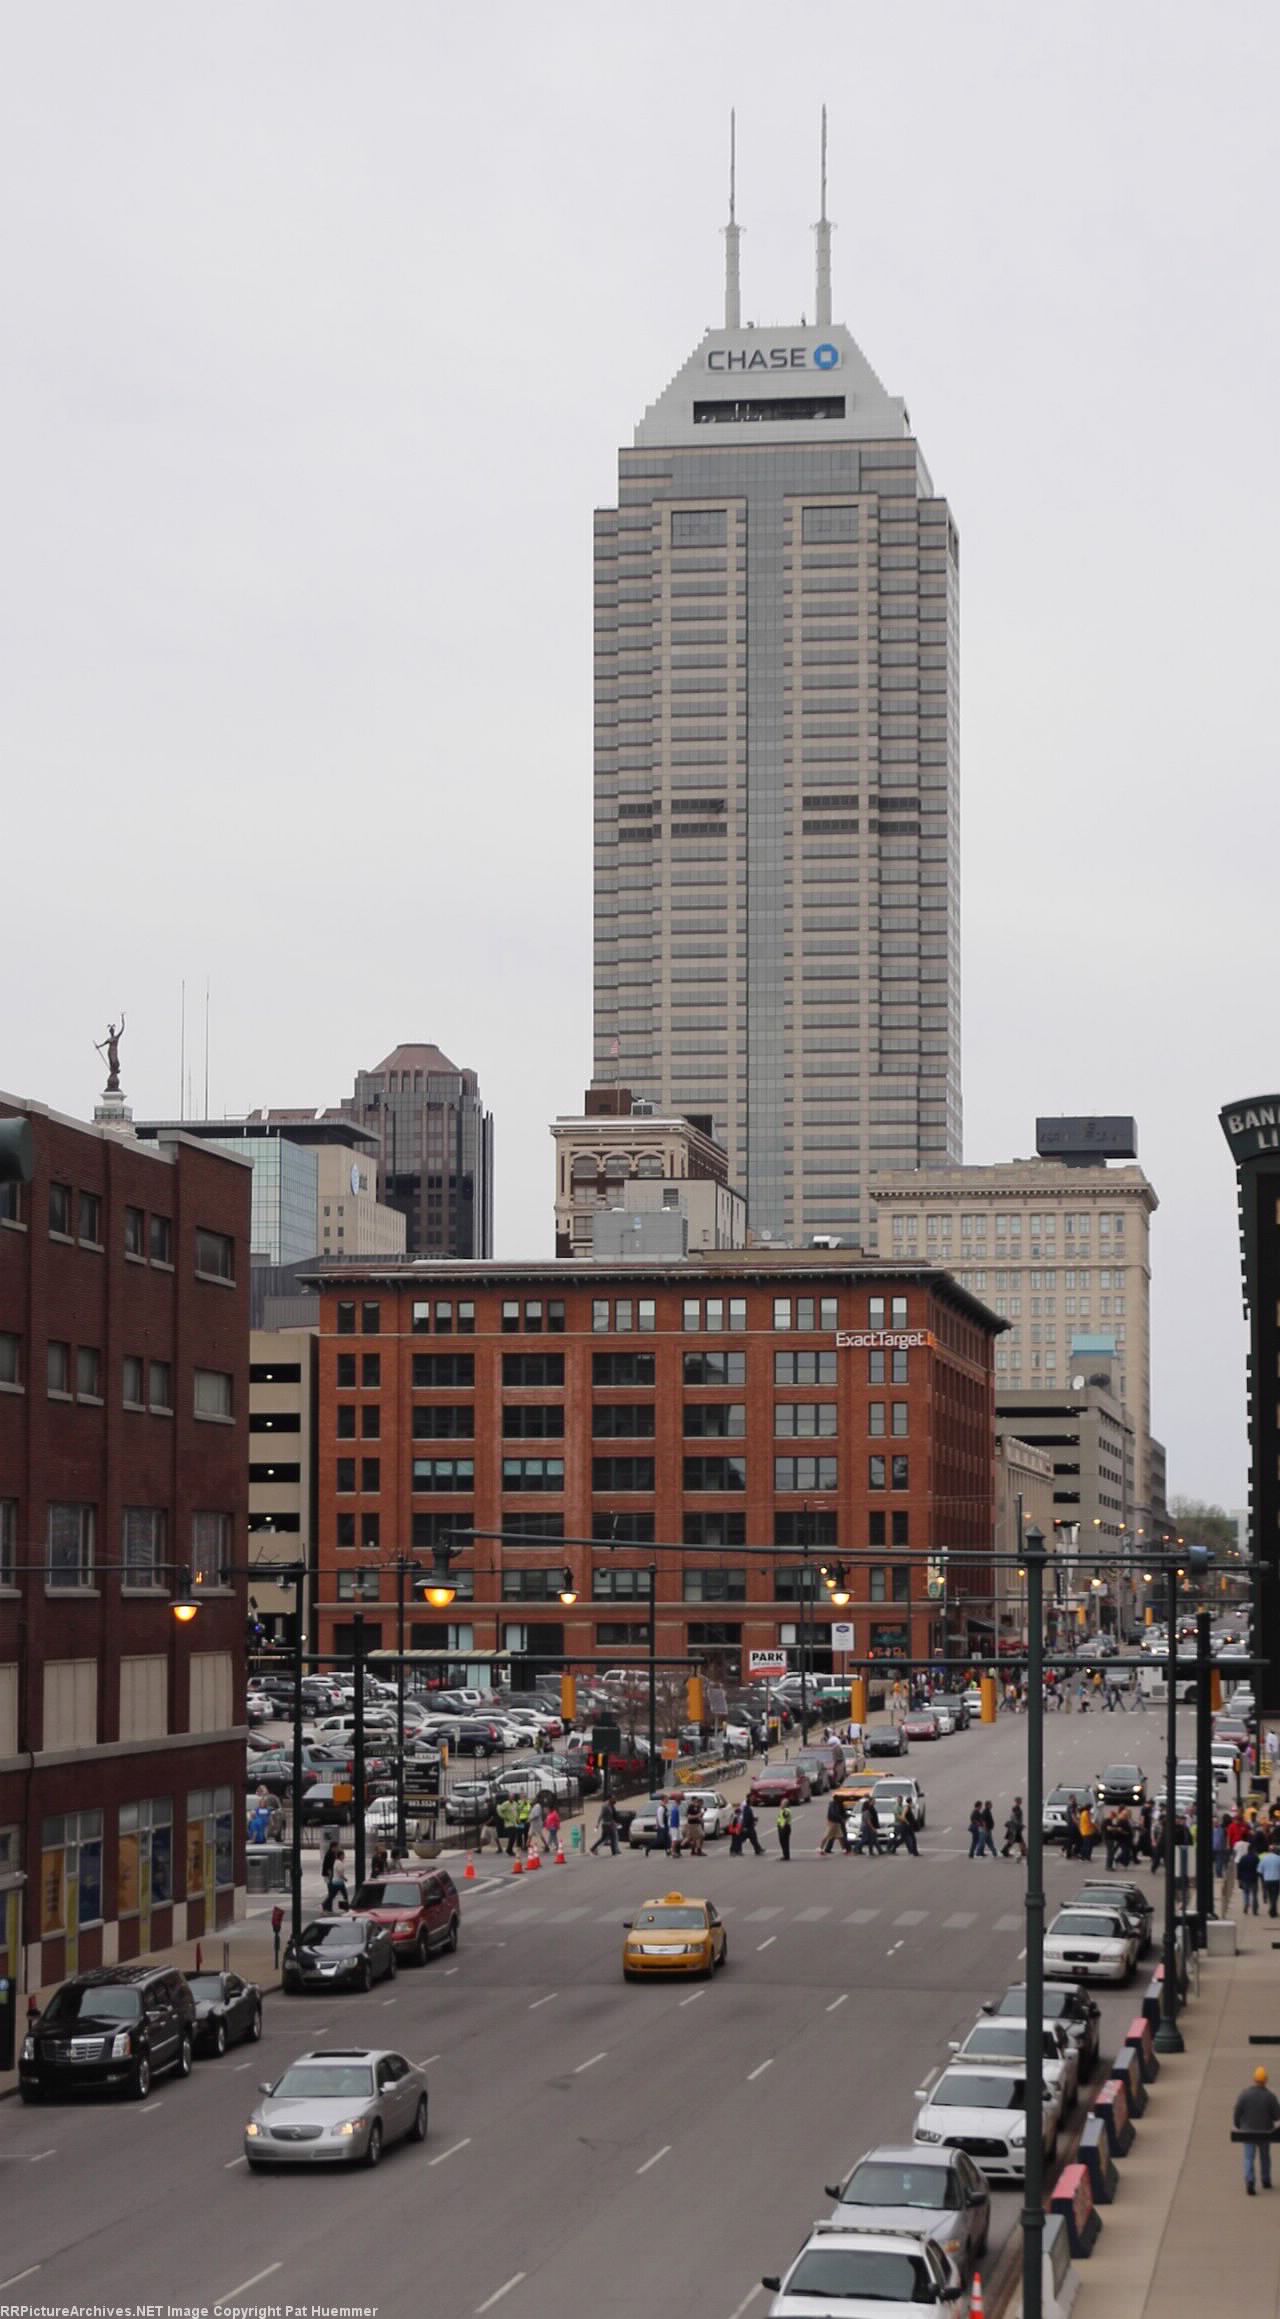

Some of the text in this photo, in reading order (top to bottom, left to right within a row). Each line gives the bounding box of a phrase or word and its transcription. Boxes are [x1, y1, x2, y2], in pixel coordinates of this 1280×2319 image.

[707, 347, 807, 371] CHASE
[1228, 1105, 1280, 1134] BAN
[835, 1331, 924, 1350] ExactTarget
[751, 1652, 784, 1662] PARK
